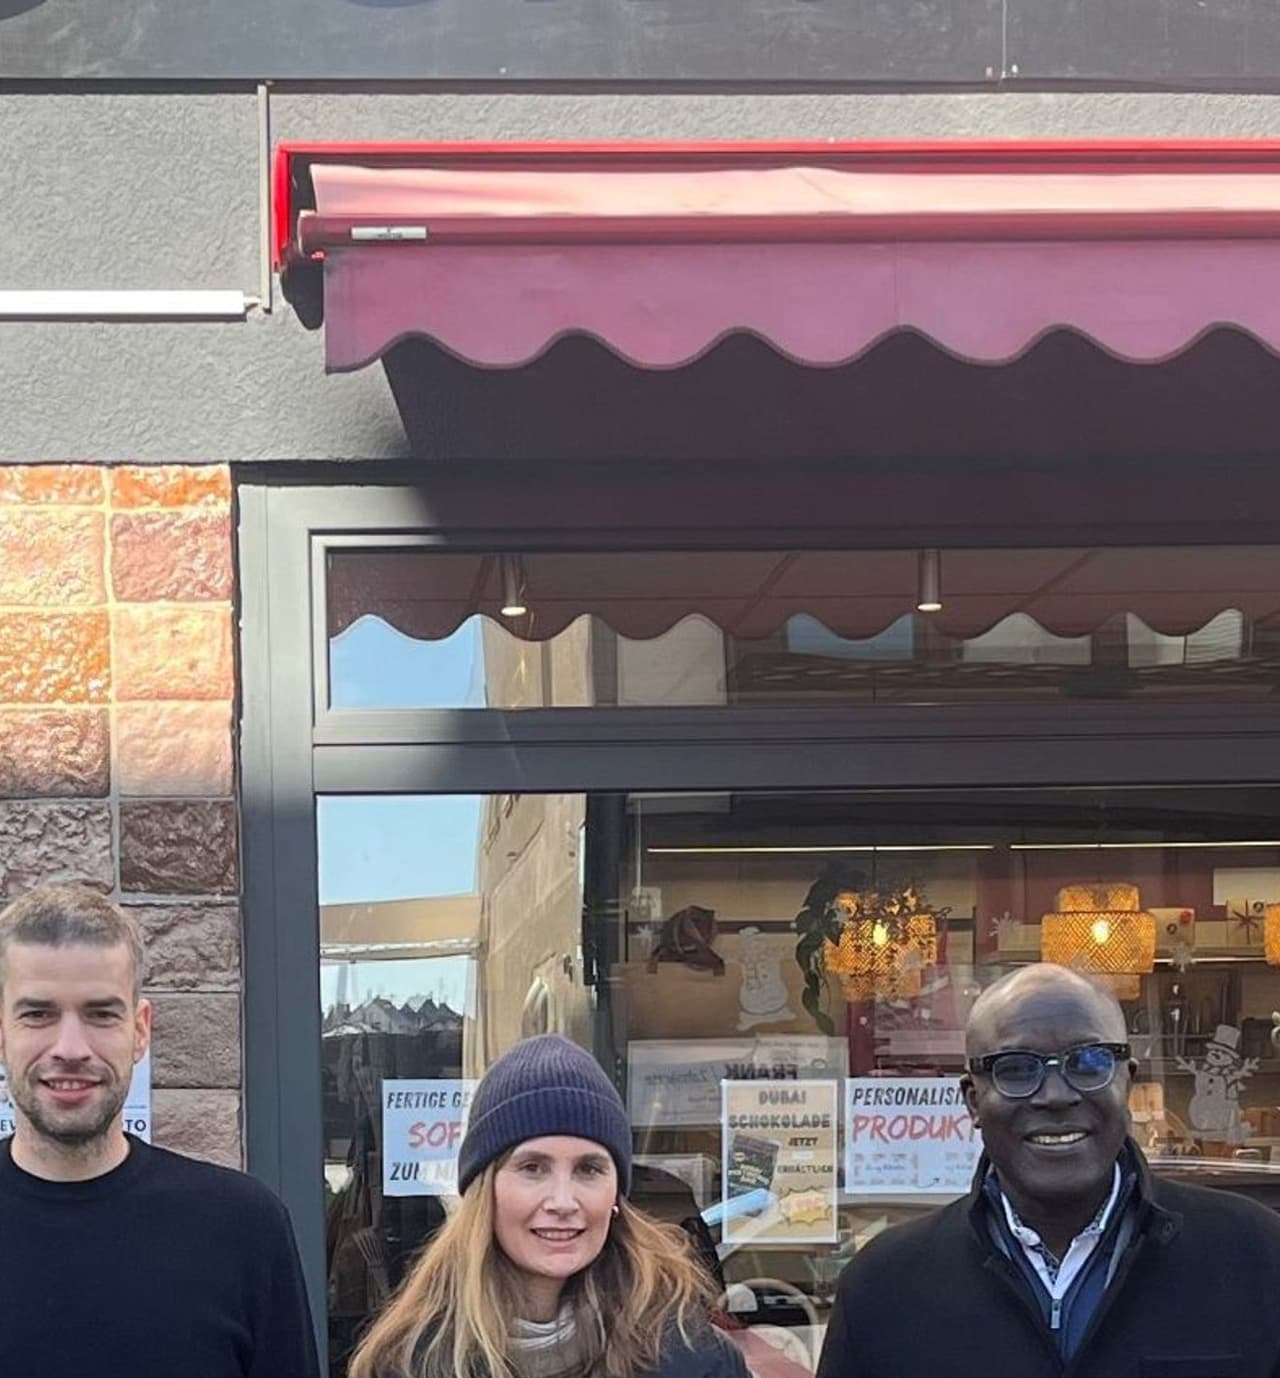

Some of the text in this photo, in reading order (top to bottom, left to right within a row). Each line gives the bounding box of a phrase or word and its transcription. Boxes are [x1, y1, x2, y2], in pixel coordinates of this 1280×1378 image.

[387, 1092, 448, 1109] FERTIGE
[728, 1113, 831, 1129] SCHOKOLADE
[409, 1120, 462, 1150] SOF
